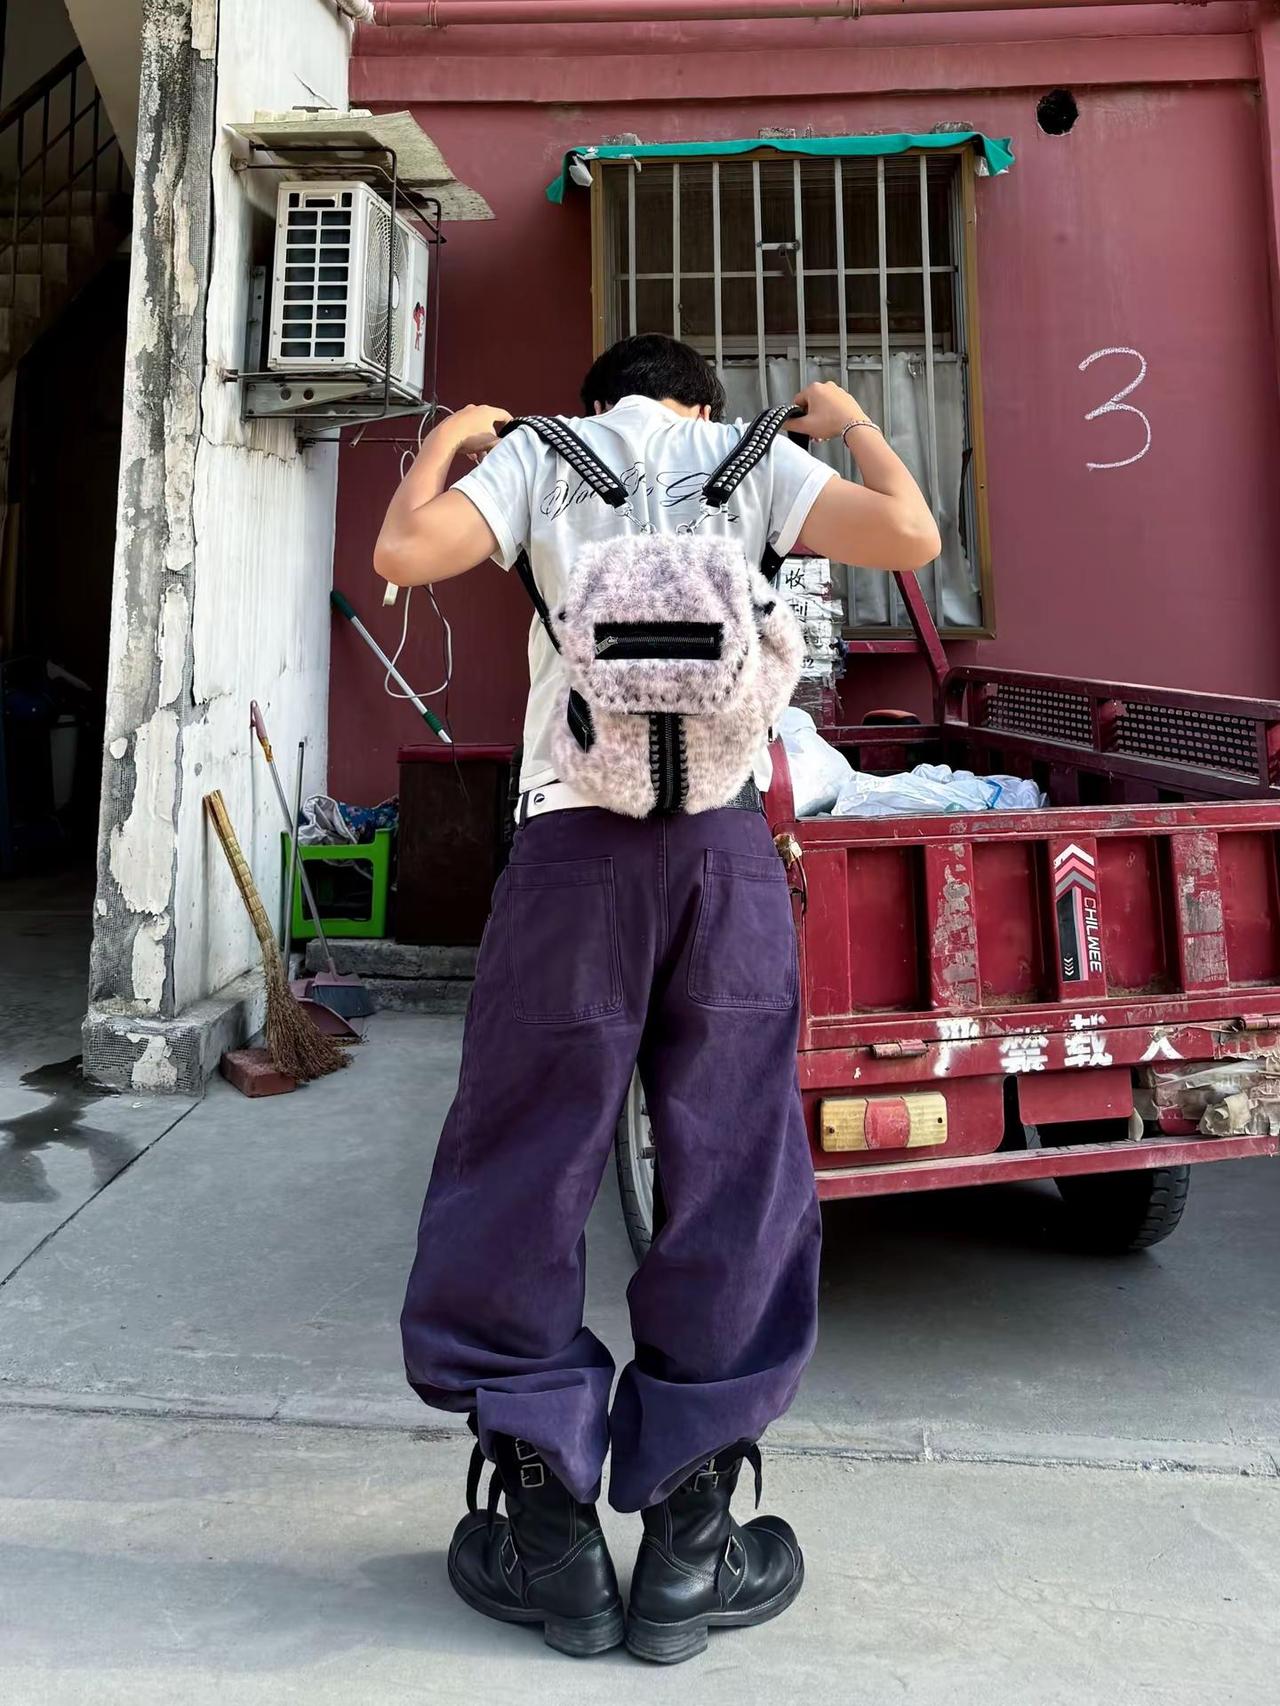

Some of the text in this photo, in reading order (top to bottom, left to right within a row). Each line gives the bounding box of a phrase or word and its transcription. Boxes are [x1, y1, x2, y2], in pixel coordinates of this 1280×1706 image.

[1078, 347, 1152, 471] 3
[785, 567, 806, 590] 收
[1084, 897, 1102, 974] CHILWEE
[933, 1013, 1184, 1077] 严禁载人
